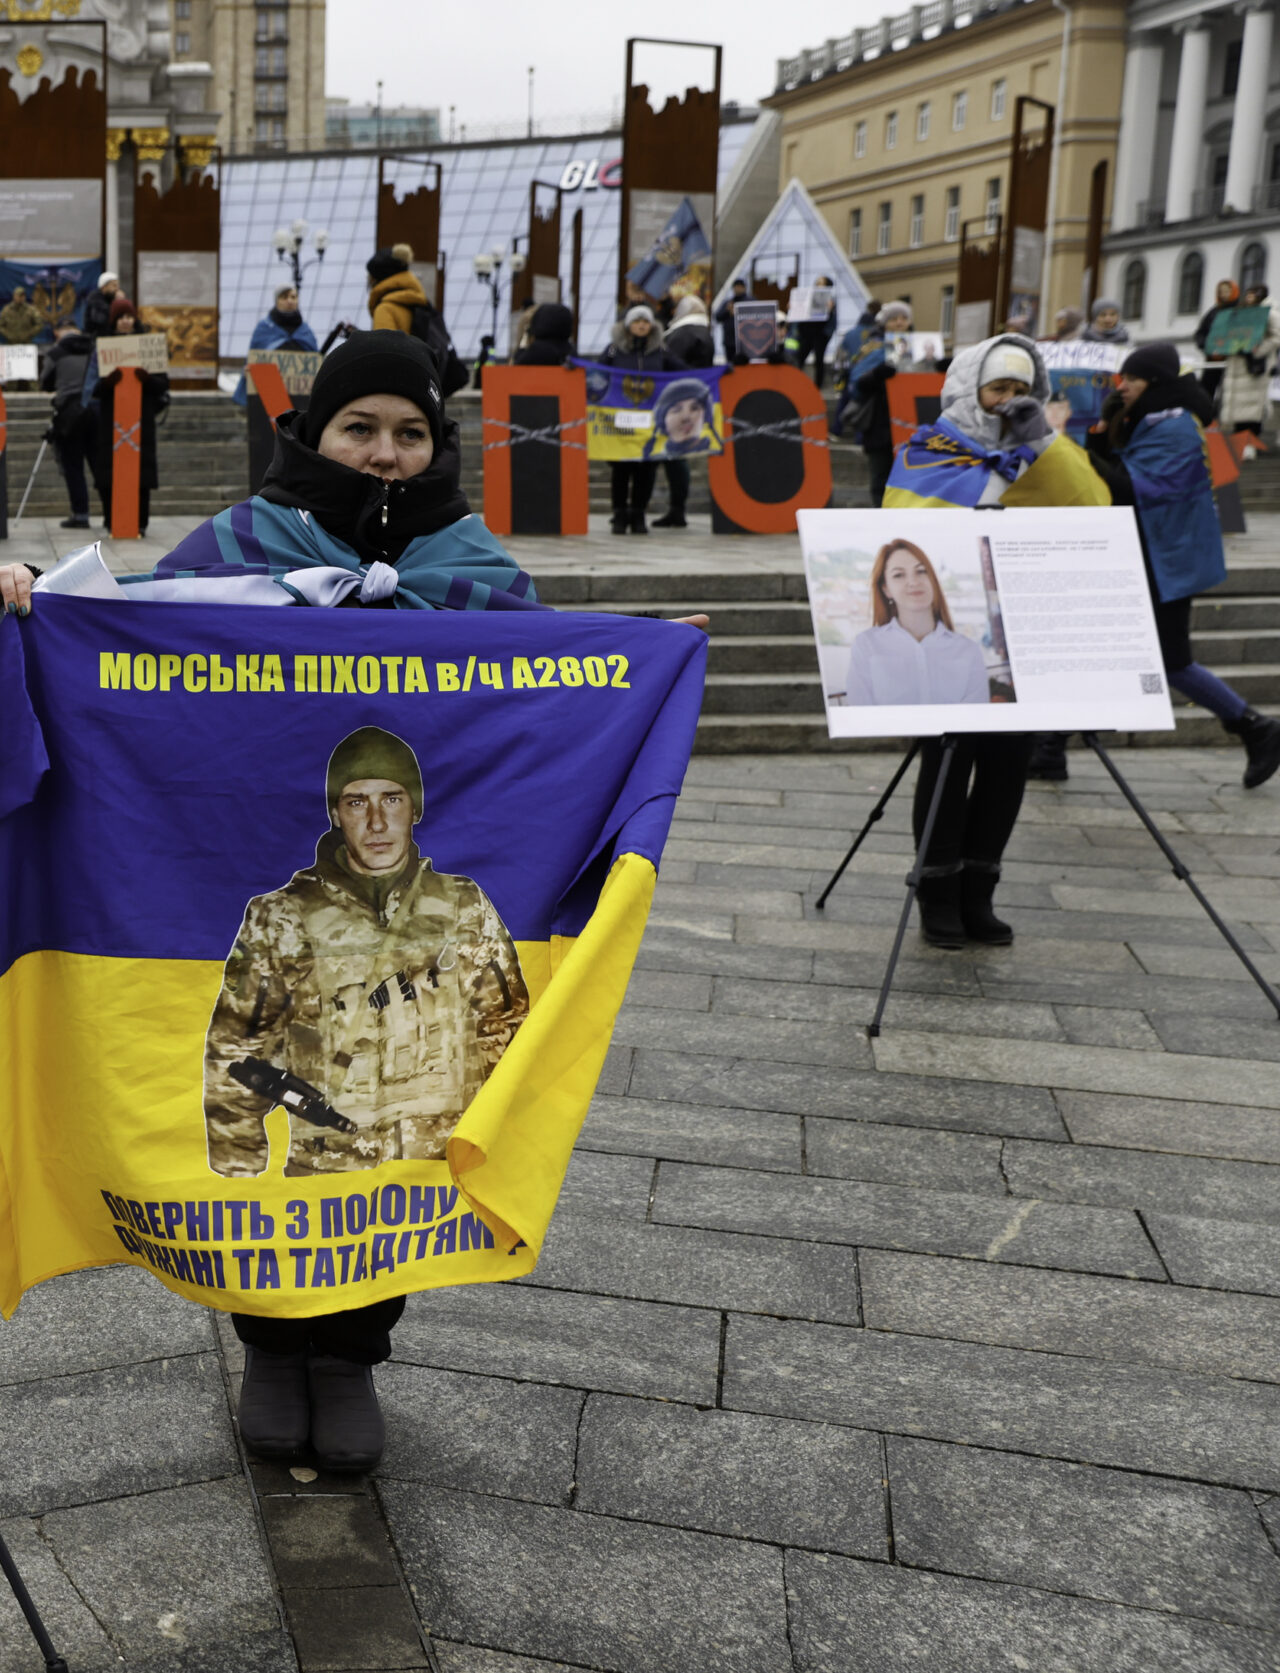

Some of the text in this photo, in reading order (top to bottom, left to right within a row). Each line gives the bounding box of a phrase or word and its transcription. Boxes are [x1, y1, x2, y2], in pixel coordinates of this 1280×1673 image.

[100, 652, 631, 694] МОРСЬКА ПІХОТА в/ч А2802
[101, 1190, 274, 1241] ПОВЕРНІТЬ
[232, 1248, 280, 1290] ТА
[370, 1212, 495, 1280] ДІТЯМ
